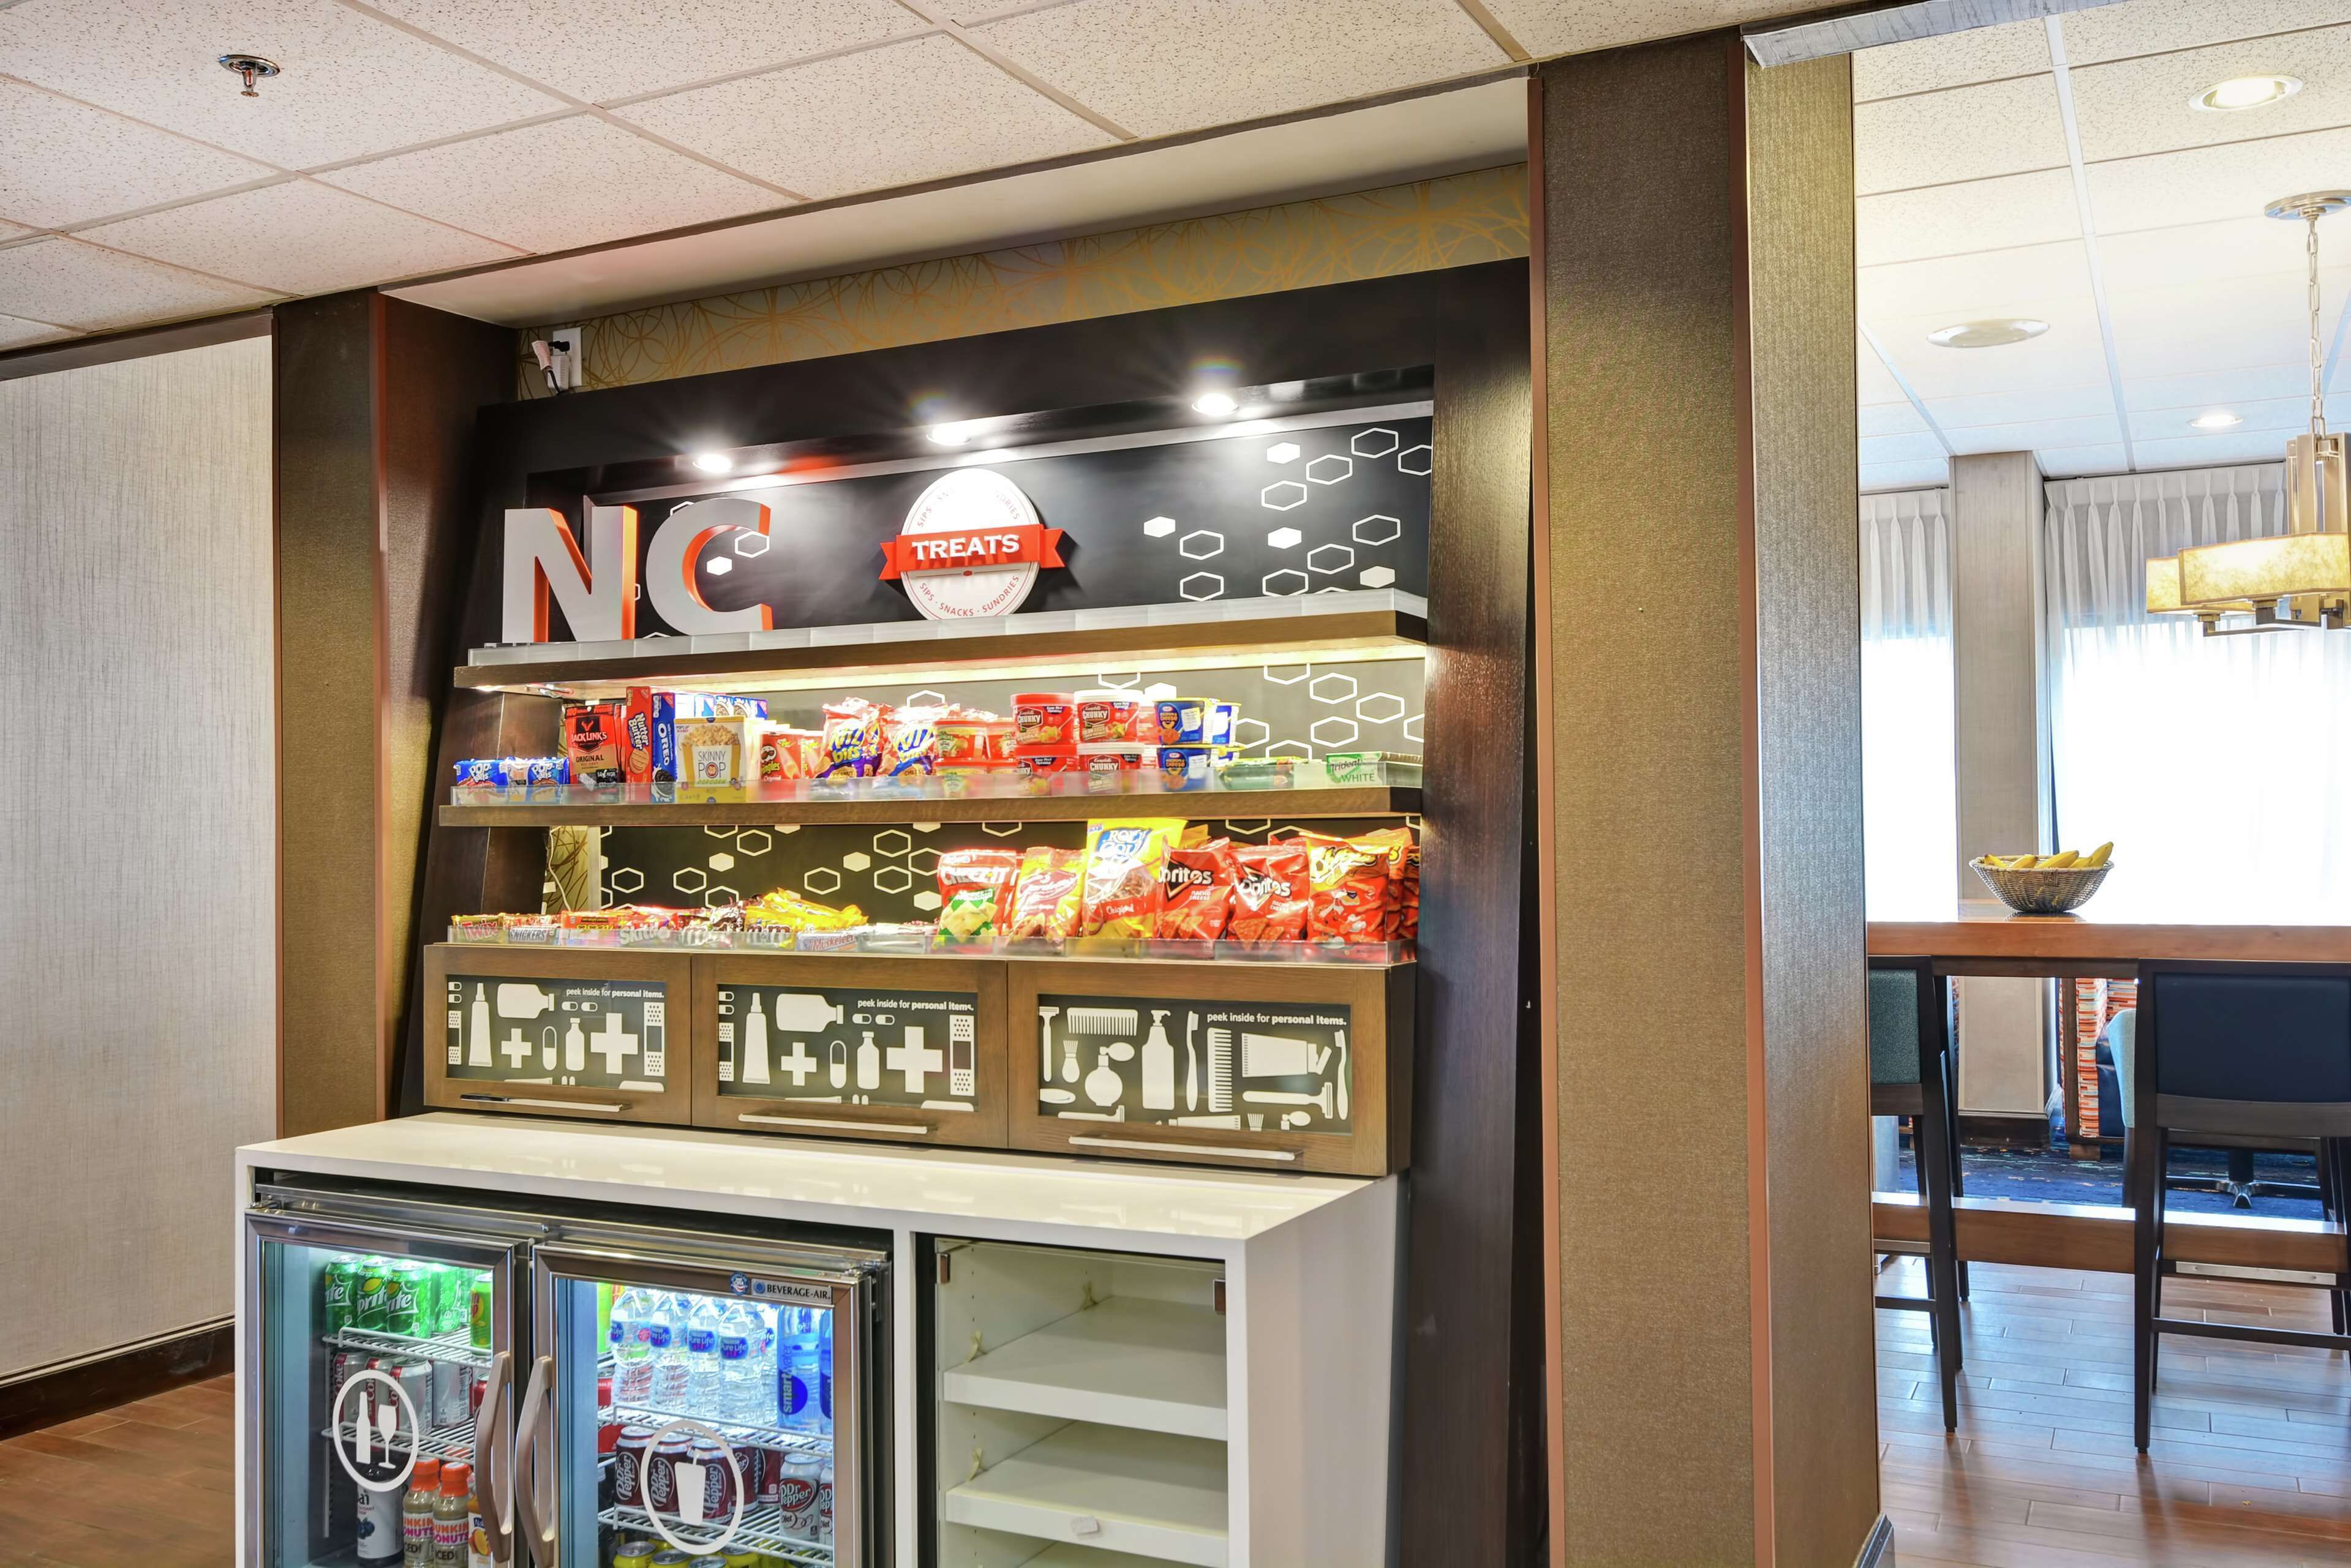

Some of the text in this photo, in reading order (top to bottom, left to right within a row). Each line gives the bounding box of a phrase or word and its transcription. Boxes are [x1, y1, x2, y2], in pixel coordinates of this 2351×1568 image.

[911, 534, 1020, 561] TREATS
[502, 497, 773, 643] NC
[920, 575, 1020, 617] SIPS SNACKS SUNDRIES
[628, 719, 642, 751] Butter
[634, 712, 649, 747] Nutter
[658, 722, 670, 766] OREO
[576, 754, 604, 763] ORIGINAL
[698, 749, 726, 762] SKINNY
[698, 762, 726, 779] POP
[1089, 762, 1119, 772] CHUNKY
[1331, 759, 1362, 772] Trident
[1341, 773, 1375, 782] WHITE
[1159, 867, 1213, 885] Doritos
[1241, 875, 1292, 898] Doritos
[510, 928, 547, 942] SNICKERS
[566, 987, 665, 999] peek inside for personal items.
[857, 999, 974, 1011] peek inside for personal items.
[1206, 1012, 1347, 1026] peek inside for personal items.
[616, 1455, 635, 1498] Pepper
[651, 1461, 669, 1503] Pepper
[781, 1484, 811, 1507] Pepper
